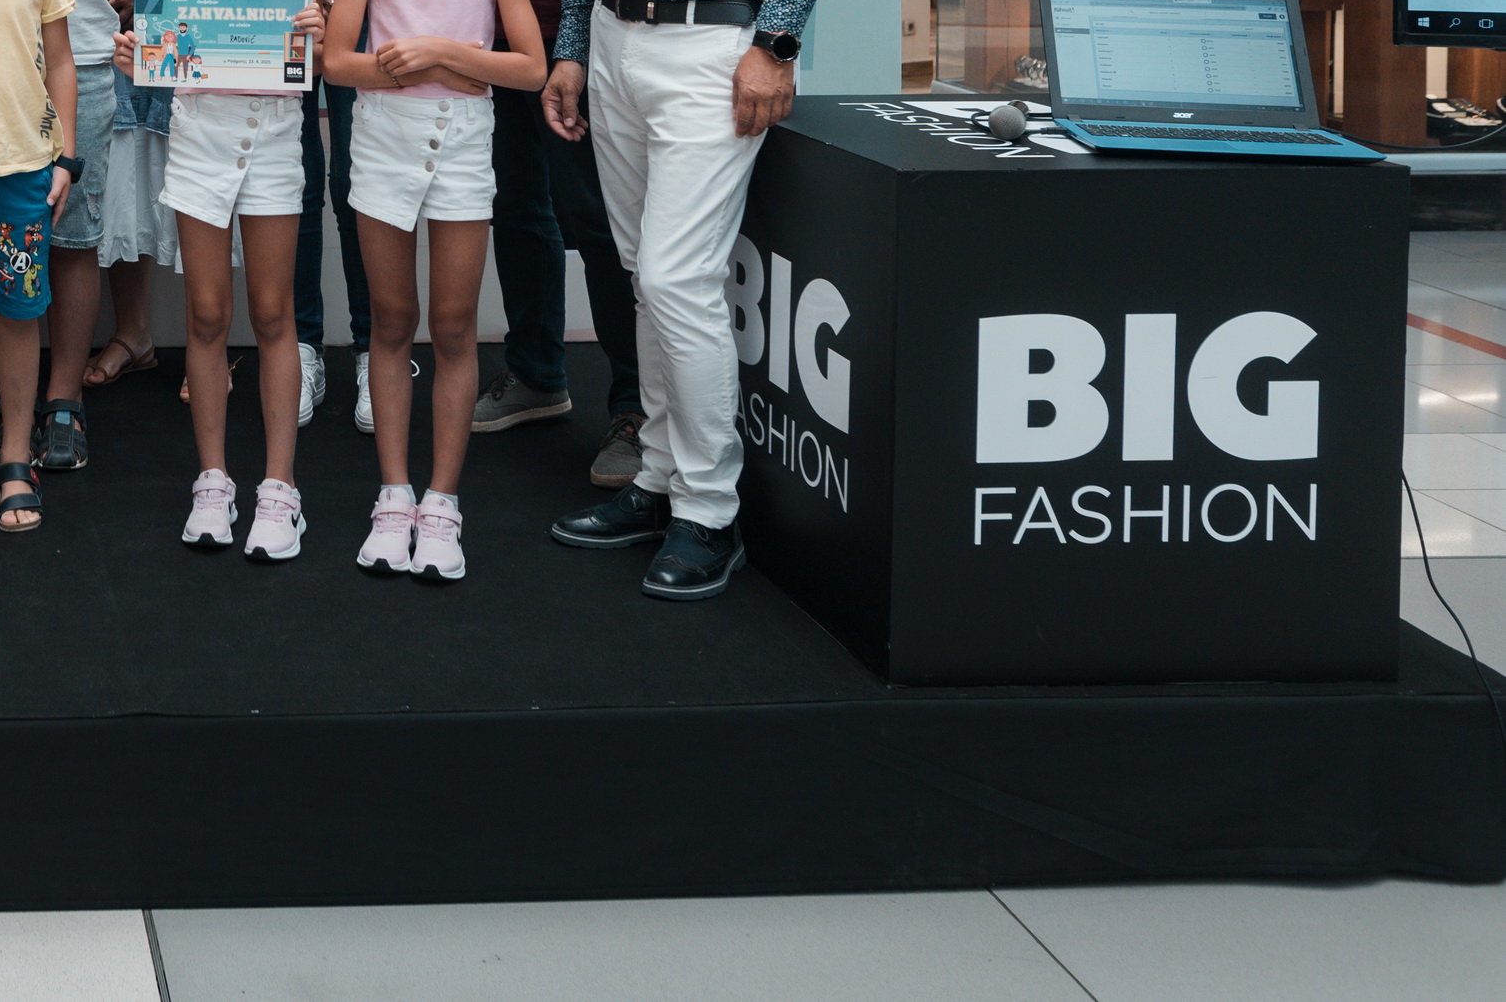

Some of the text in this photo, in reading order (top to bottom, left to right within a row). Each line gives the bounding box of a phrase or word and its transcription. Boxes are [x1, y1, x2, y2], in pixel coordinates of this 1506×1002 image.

[176, 5, 287, 22] ZAHVALNICU
[286, 66, 302, 74] BIG
[838, 103, 1056, 158] FASHION
[1173, 111, 1195, 119] acer
[723, 232, 851, 434] BIG
[976, 311, 1320, 464] BIG
[737, 380, 849, 514] ASHION
[972, 483, 1319, 546] FASHION
